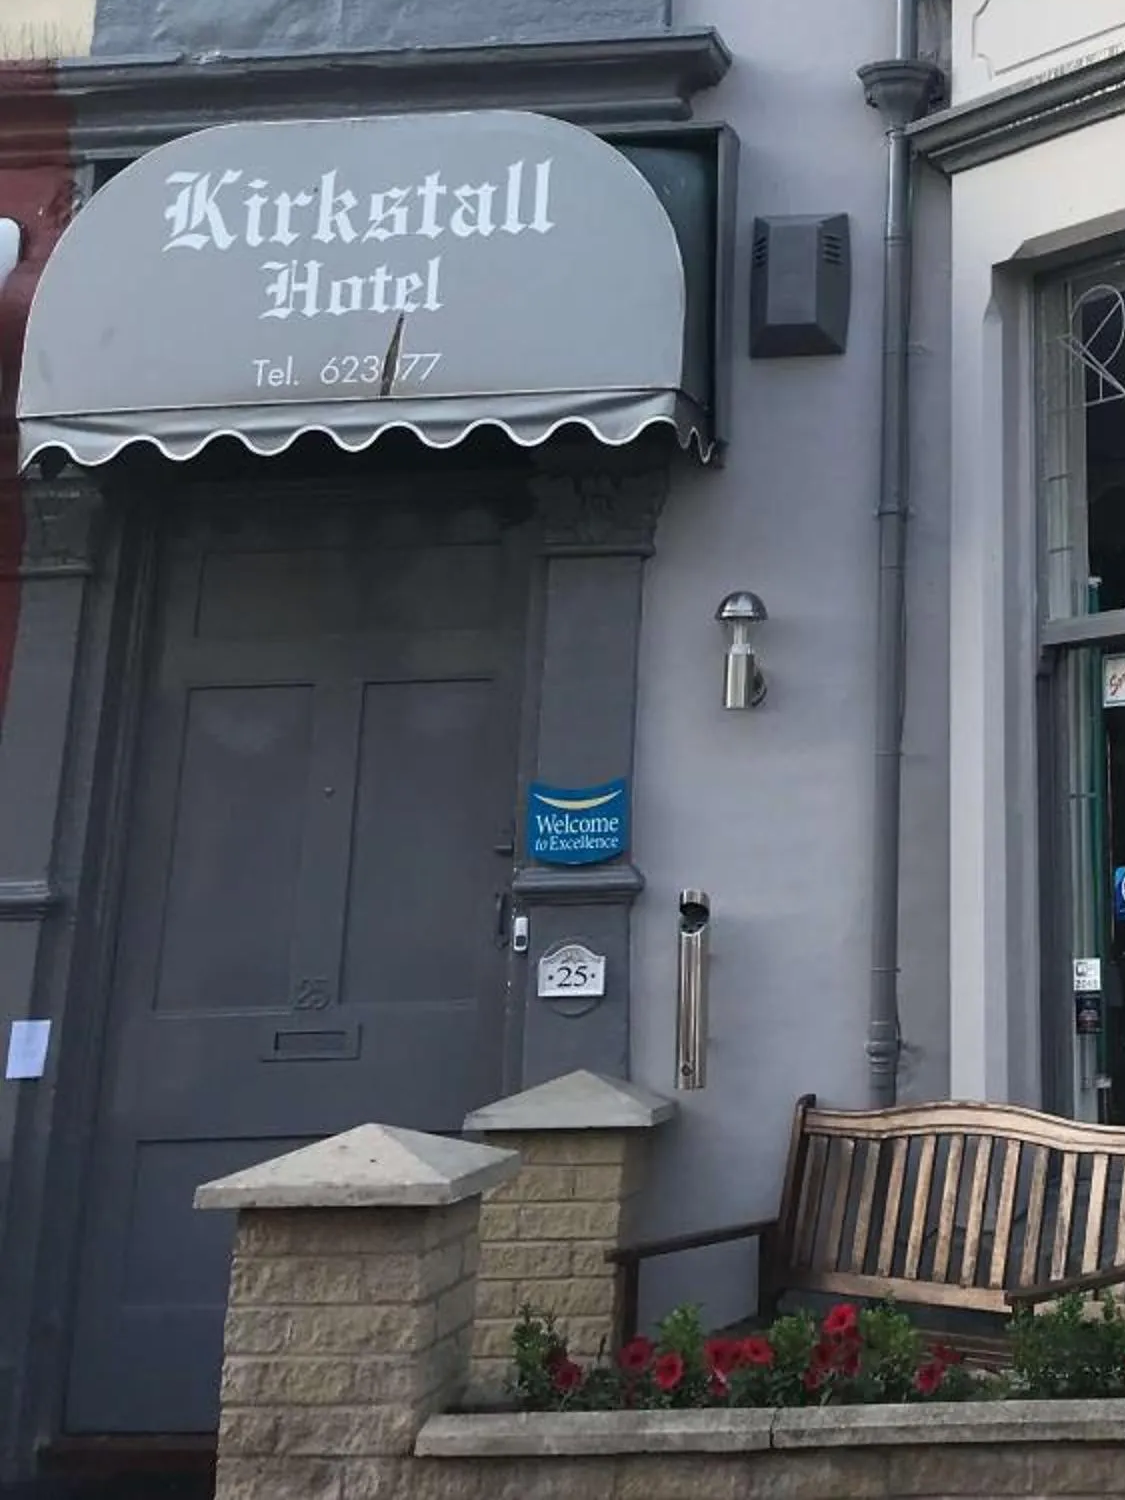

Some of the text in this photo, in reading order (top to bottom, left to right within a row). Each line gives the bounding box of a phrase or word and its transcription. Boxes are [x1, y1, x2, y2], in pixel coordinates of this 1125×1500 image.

[162, 158, 555, 252] Kirkstall
[258, 256, 445, 319] Hotel
[252, 356, 299, 387] Tel.
[535, 814, 619, 834] Welcome
[535, 834, 619, 851] to Excellence
[556, 965, 588, 987] 25
[295, 976, 331, 1011] 25
